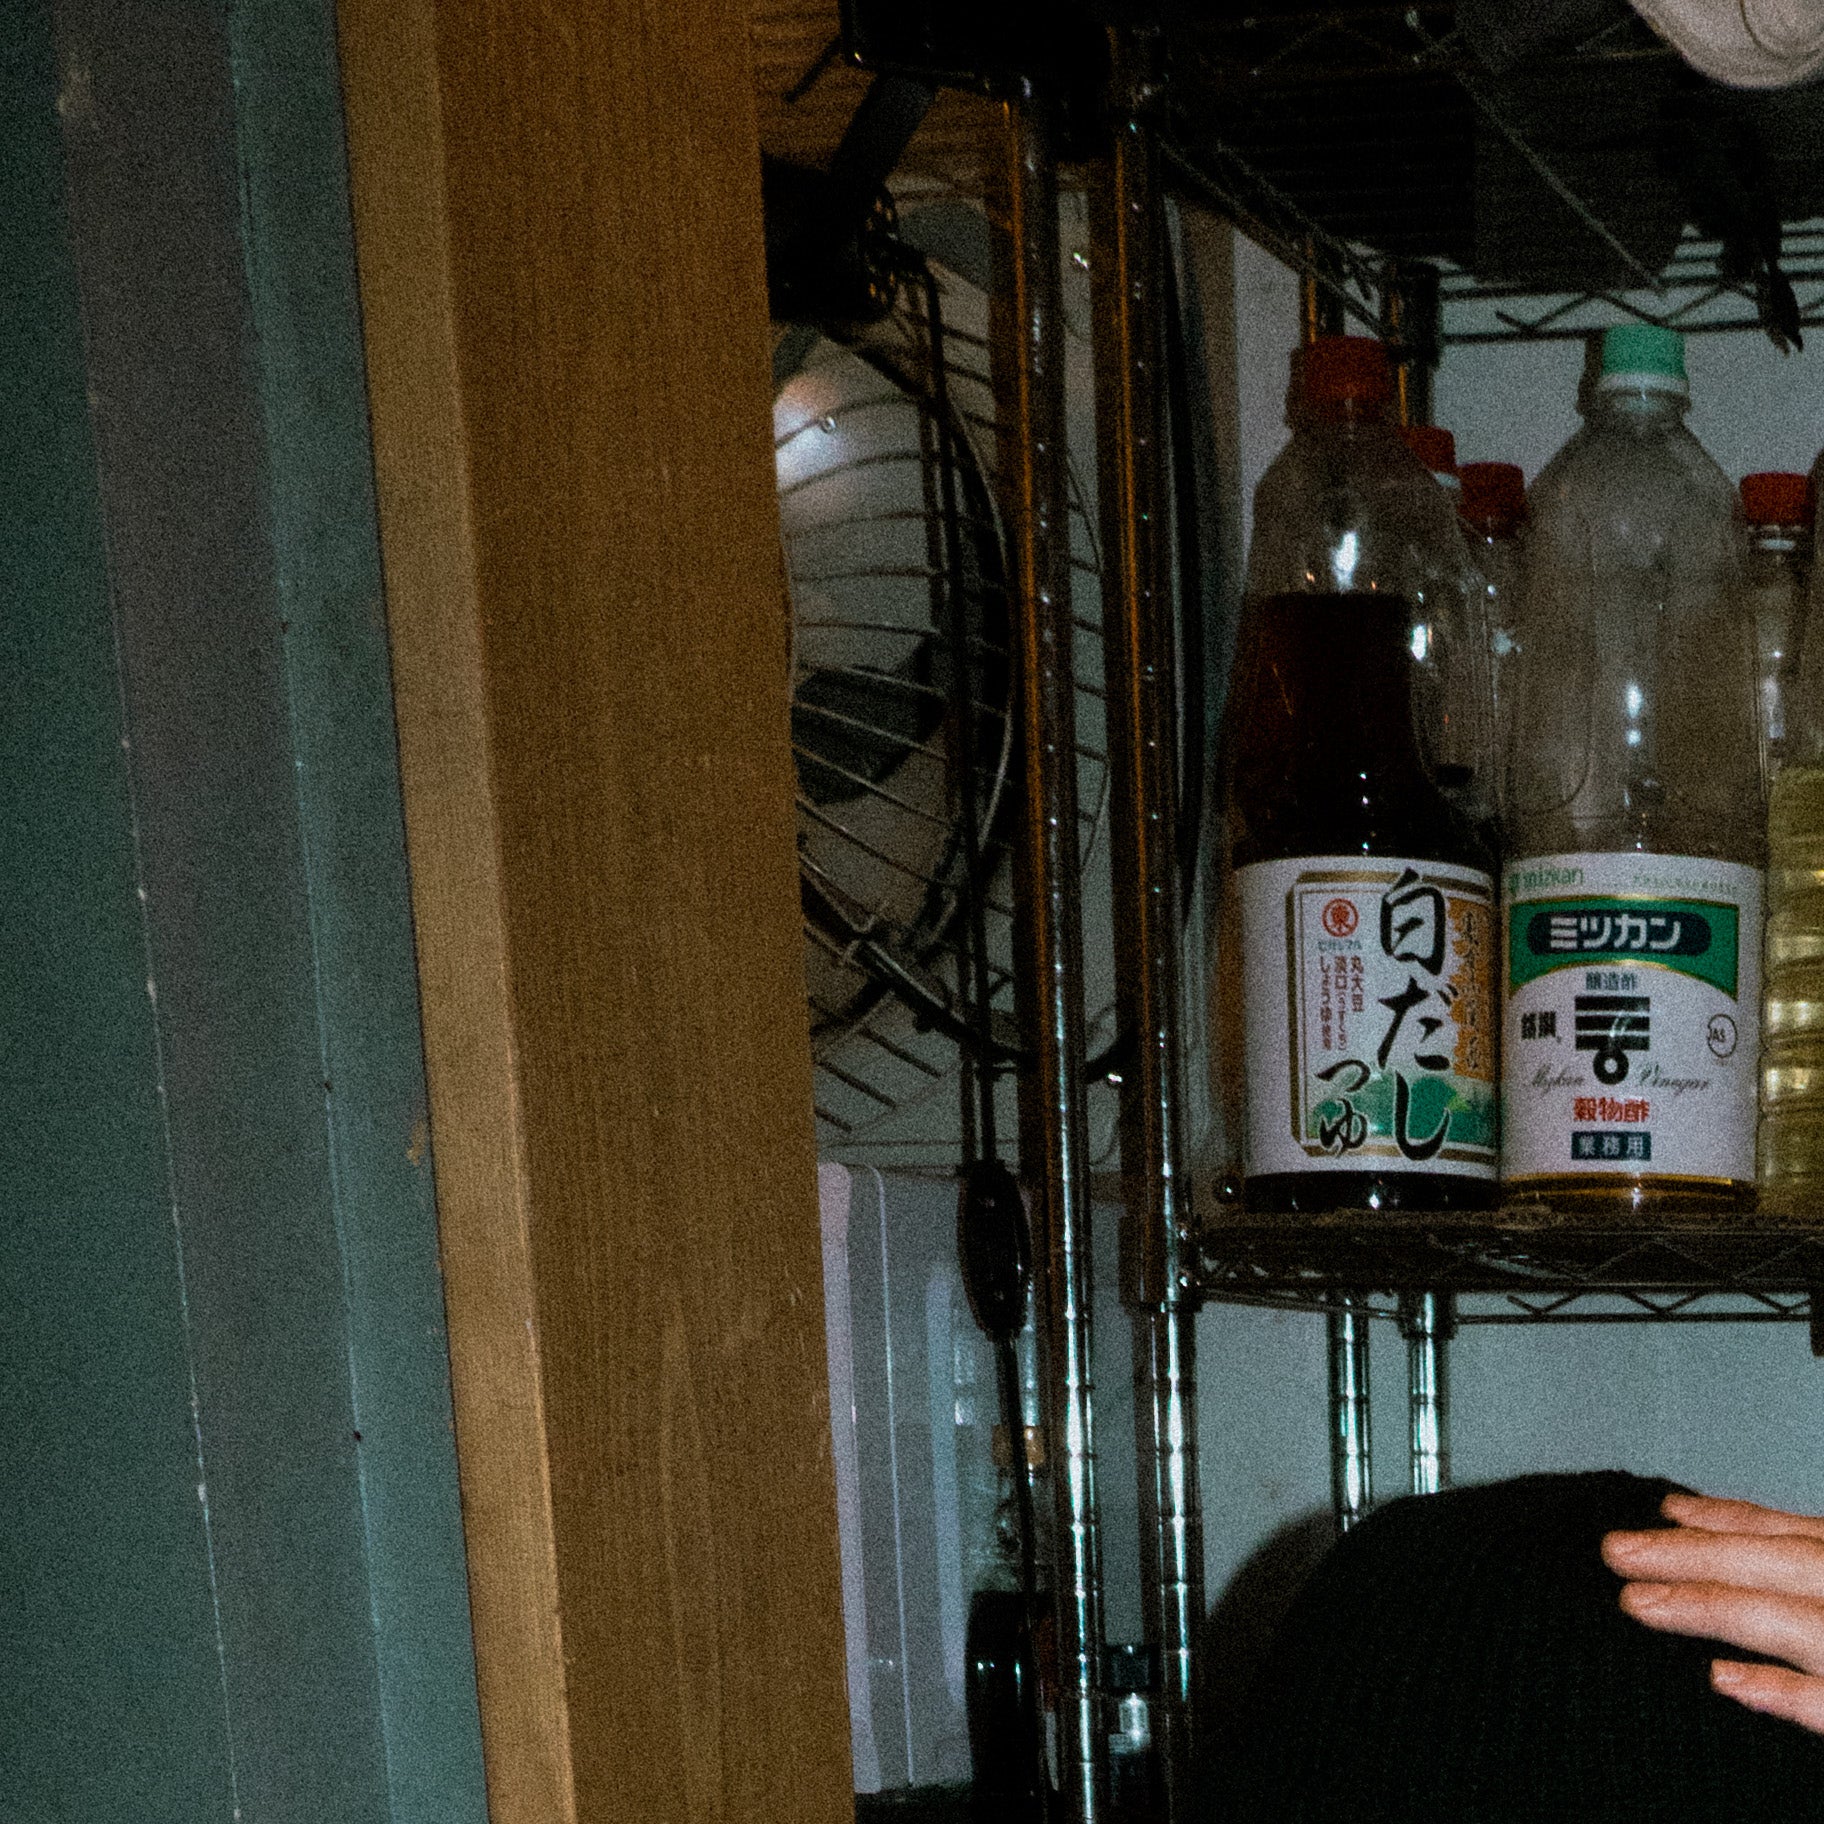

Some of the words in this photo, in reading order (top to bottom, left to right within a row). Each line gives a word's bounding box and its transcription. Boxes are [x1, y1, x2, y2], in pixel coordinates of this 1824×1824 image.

[1549, 914, 1682, 950] ミツカン
[1376, 866, 1460, 1162] 白だし
[1315, 1057, 1372, 1158] つゆ
[1573, 1098, 1650, 1122] 穀物酢
[1578, 1135, 1645, 1157] 業務用
